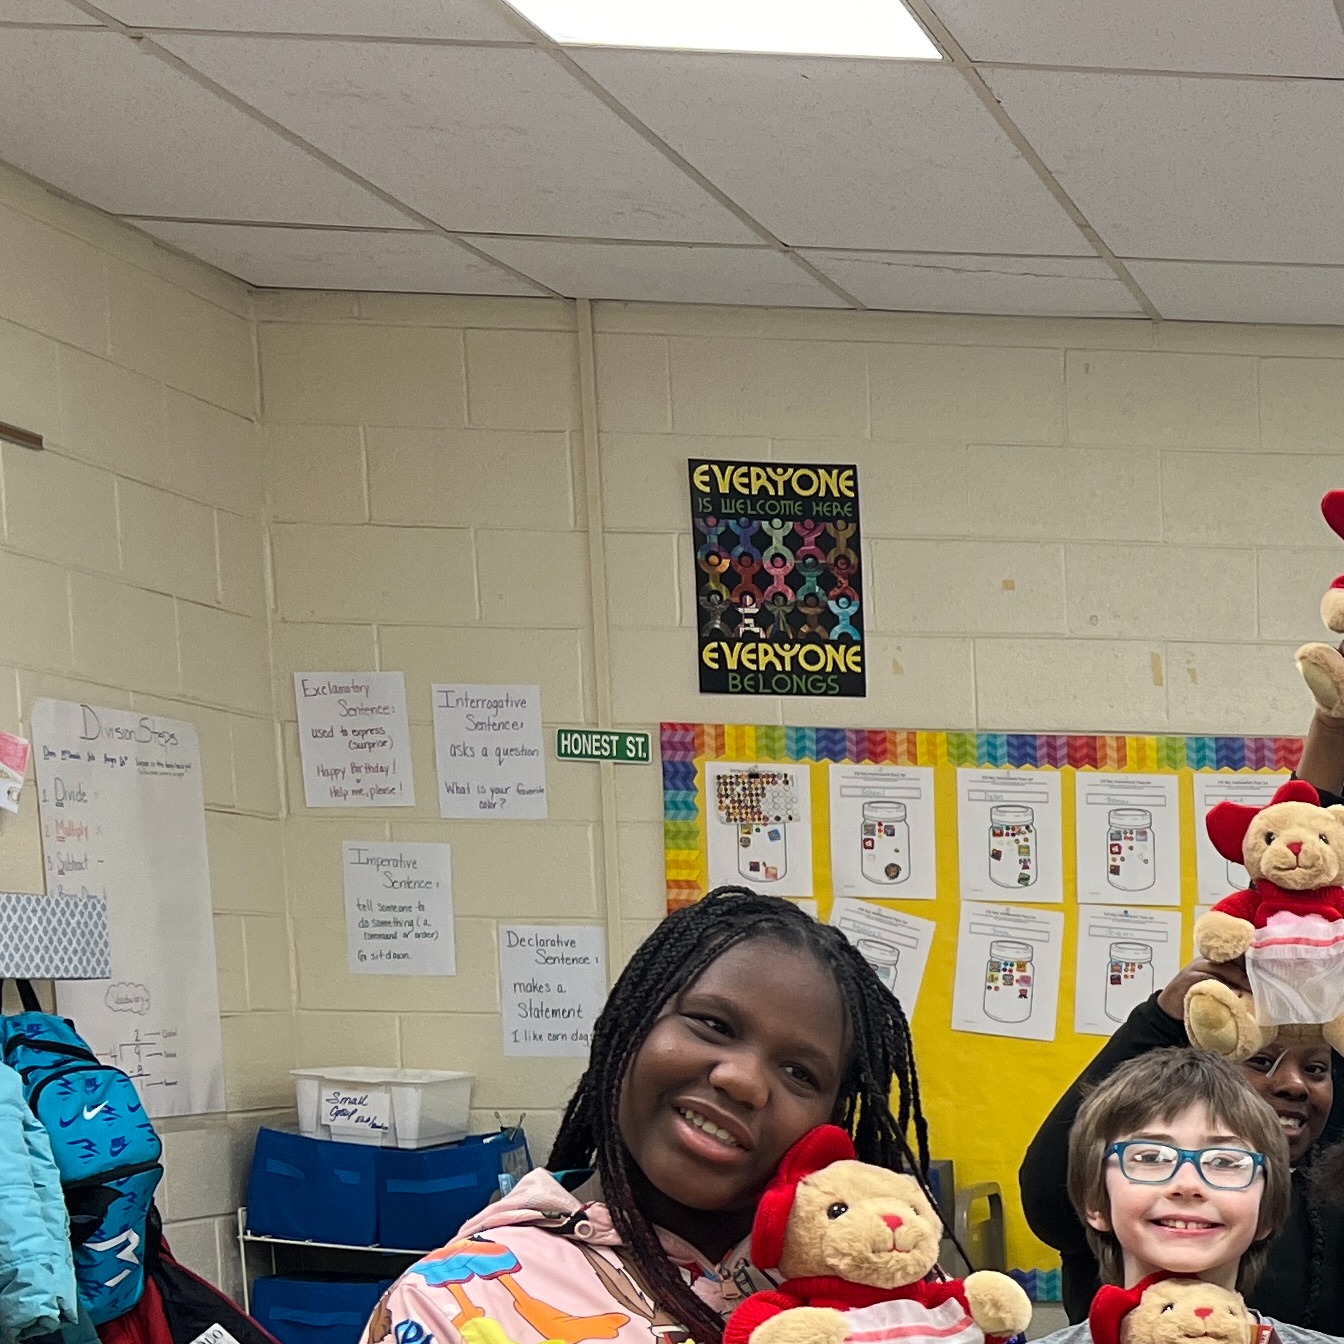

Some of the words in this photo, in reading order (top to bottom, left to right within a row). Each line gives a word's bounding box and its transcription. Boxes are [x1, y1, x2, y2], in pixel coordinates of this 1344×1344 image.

[693, 464, 855, 498] EVERYONE
[698, 497, 713, 513] IS
[721, 498, 803, 516] WELCOME
[812, 501, 853, 517] HERE
[702, 641, 862, 673] EVERYONE
[302, 679, 369, 698] Exclamatory
[729, 674, 840, 694] BELONGS
[437, 690, 527, 717] Interrogative
[80, 704, 136, 741] Division
[311, 725, 334, 738] used
[352, 727, 385, 739] express
[449, 741, 475, 757] asks
[481, 747, 488, 757] a
[495, 744, 539, 766] question
[561, 734, 619, 757] HONEST
[626, 737, 648, 759] ST.
[317, 765, 346, 781] Happy
[330, 786, 348, 801] Help
[445, 782, 470, 794] What
[477, 785, 486, 794] is
[490, 786, 511, 800] your
[348, 848, 417, 871] Imperative
[357, 898, 373, 911] tell
[377, 902, 412, 912] someone
[358, 917, 369, 928] do
[372, 917, 414, 933] something
[506, 931, 576, 948] Declarative
[513, 978, 551, 993] makes
[557, 984, 566, 993] a
[524, 1029, 542, 1042] like
[548, 1032, 567, 1041] corn
[325, 1092, 368, 1106] Small
